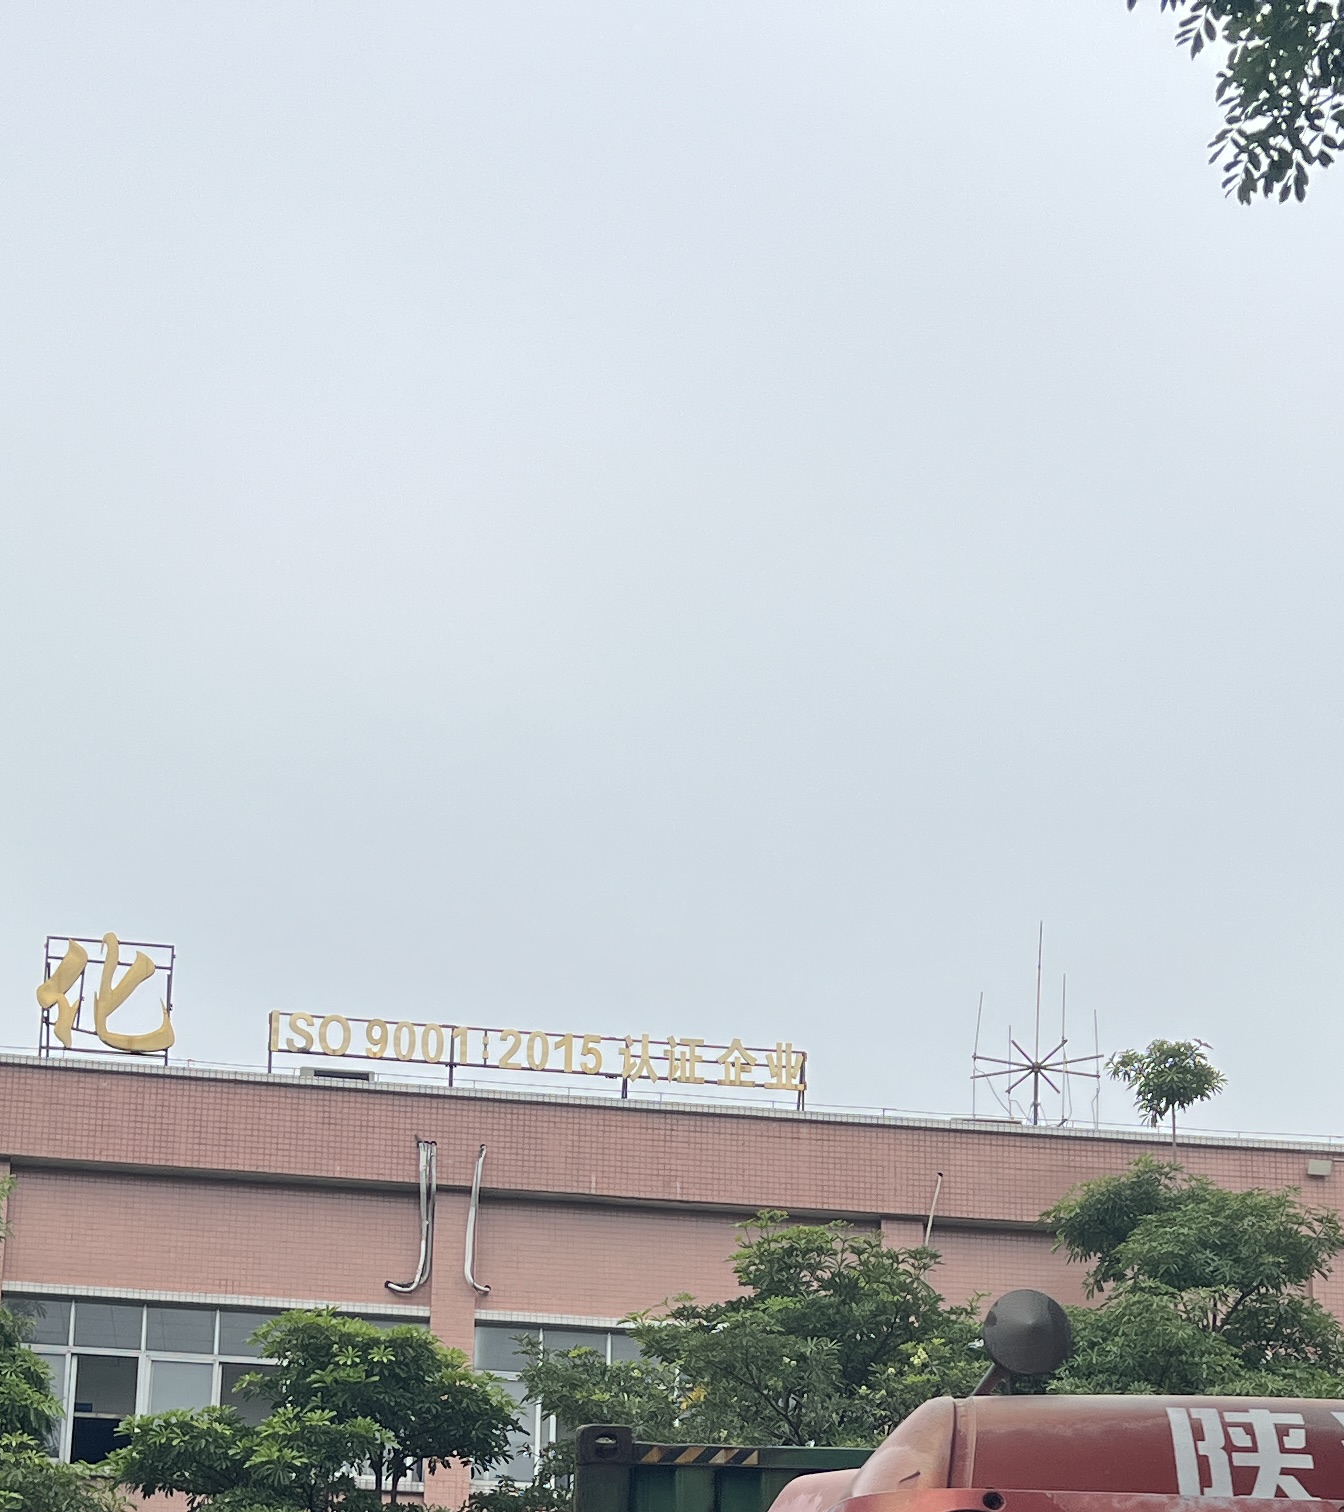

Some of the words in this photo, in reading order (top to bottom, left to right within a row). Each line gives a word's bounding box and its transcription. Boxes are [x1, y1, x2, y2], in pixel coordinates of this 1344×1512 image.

[269, 1009, 351, 1056] ISO
[365, 1018, 603, 1075] 9001:2015
[618, 1033, 806, 1091] 认证企业
